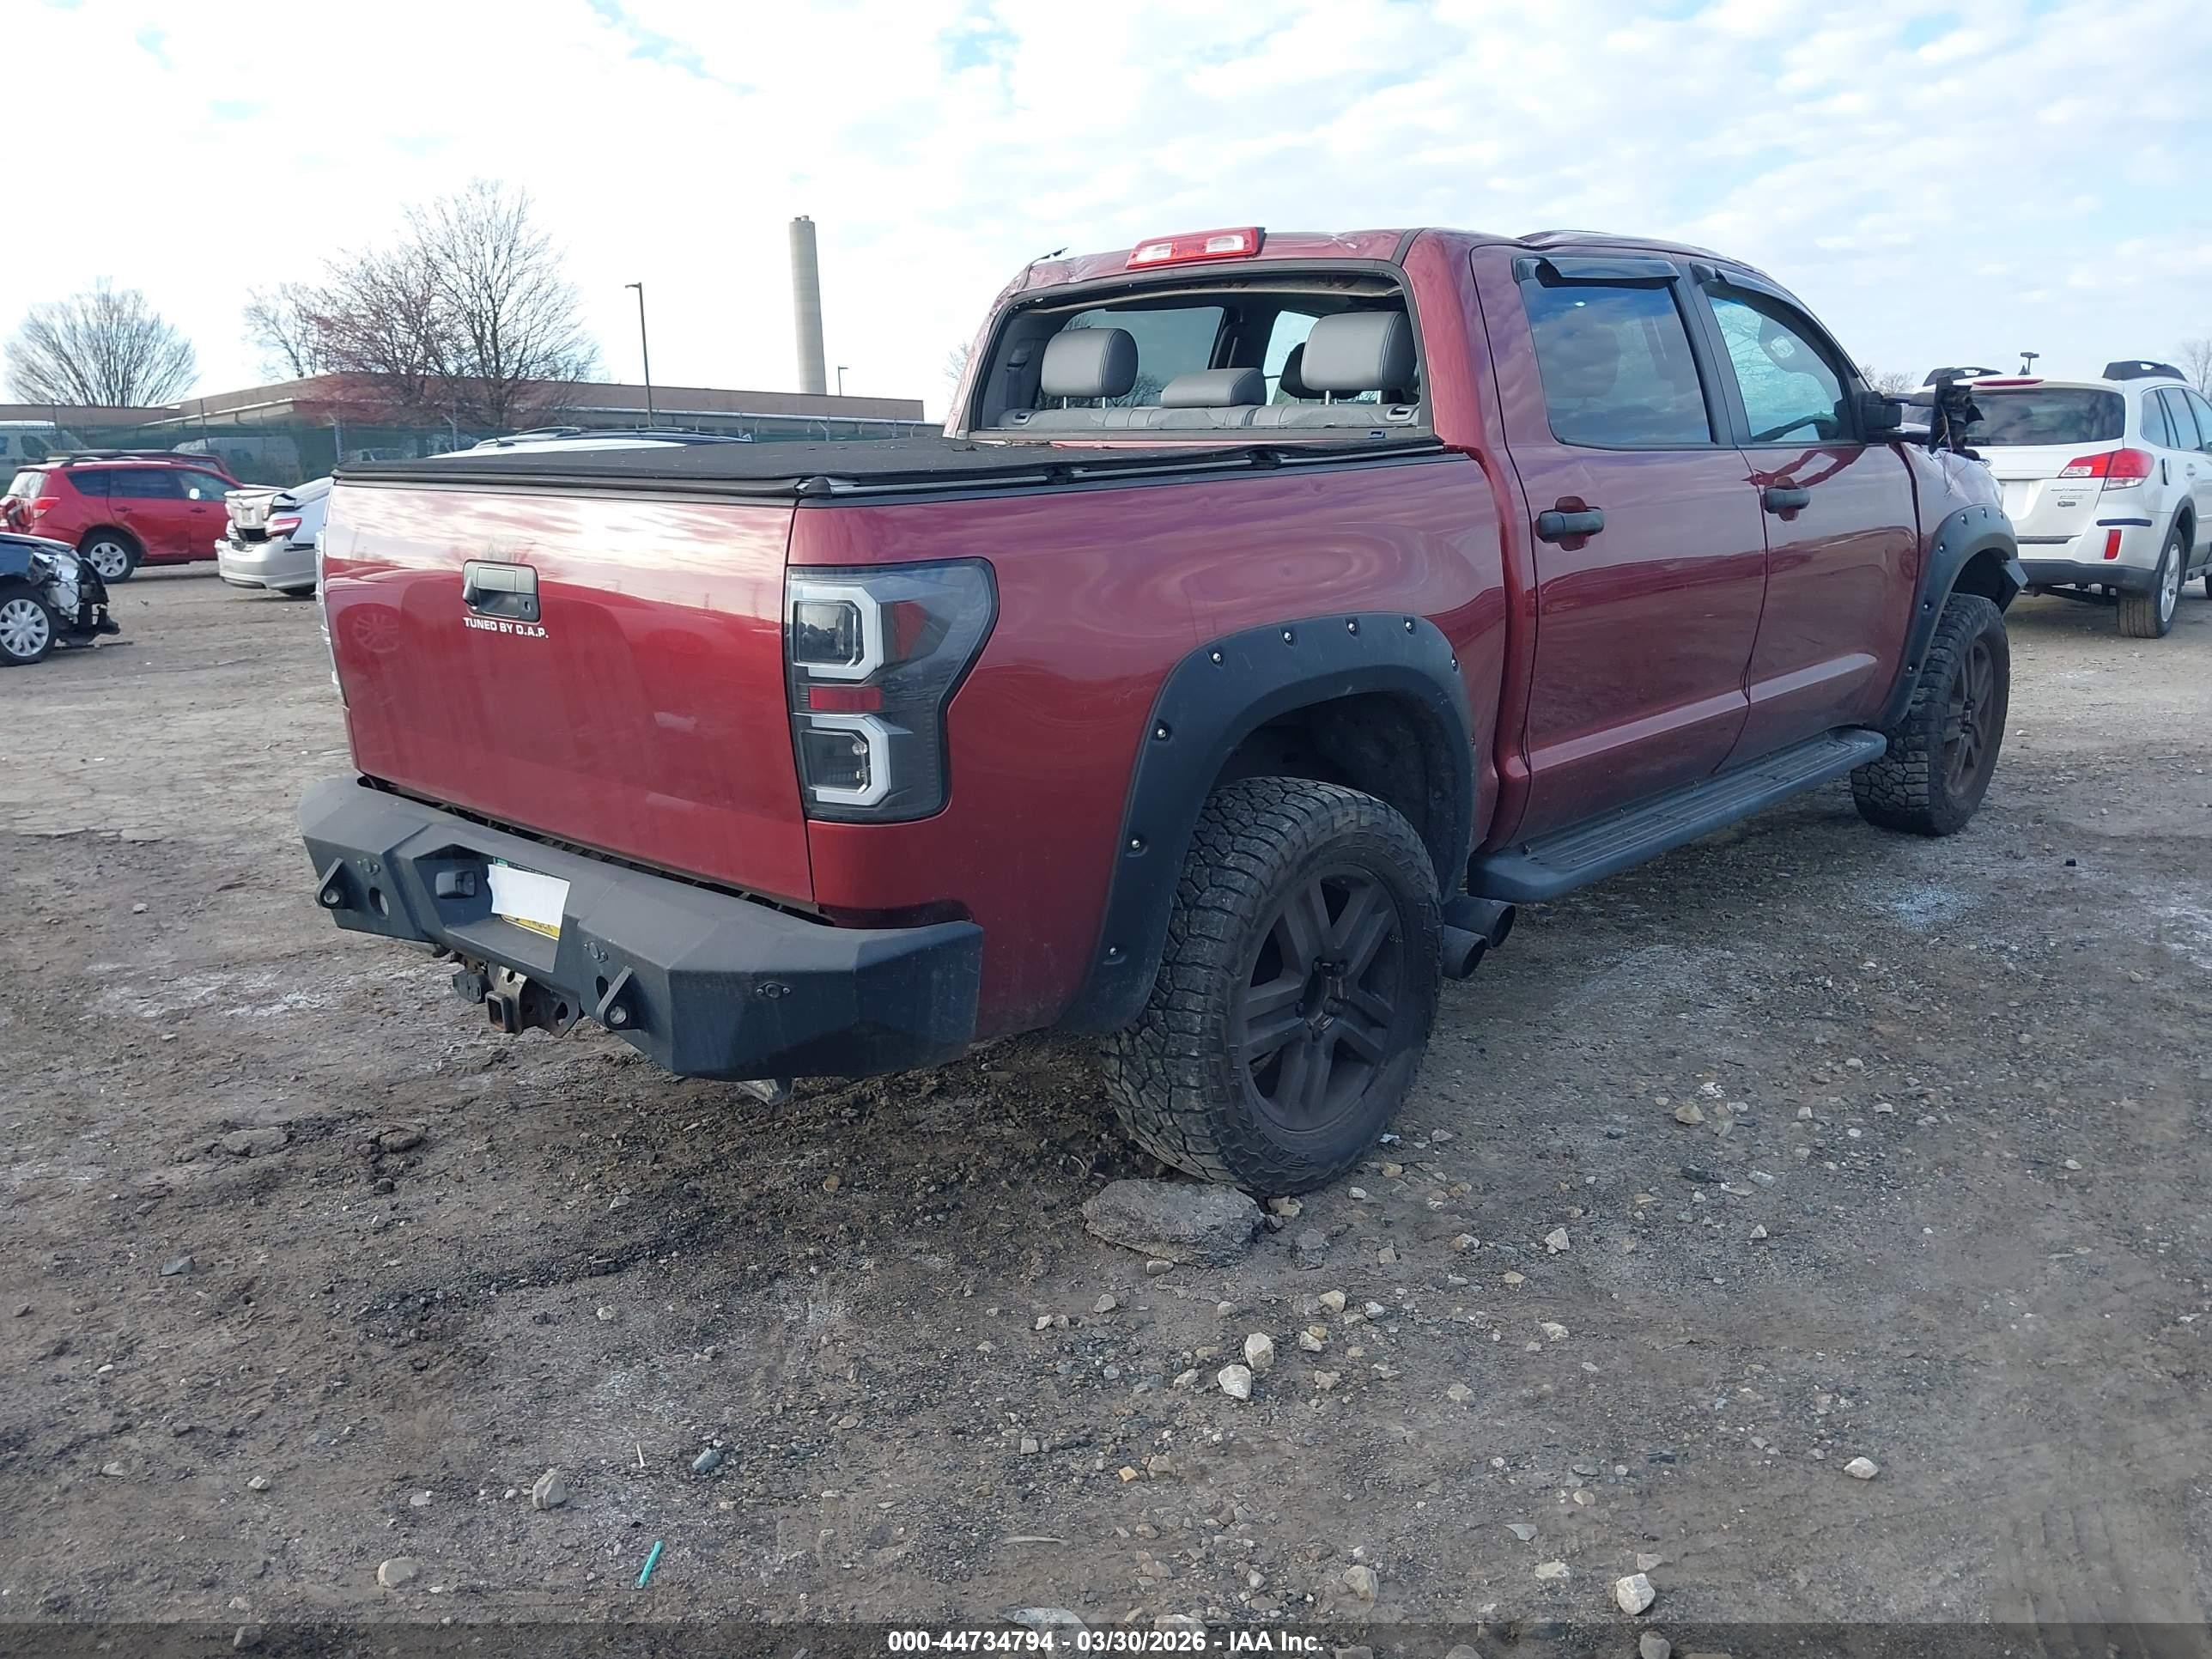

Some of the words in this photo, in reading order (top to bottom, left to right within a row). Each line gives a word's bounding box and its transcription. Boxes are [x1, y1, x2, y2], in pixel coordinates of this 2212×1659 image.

[462, 617, 497, 631] TUNED
[499, 622, 514, 634] BY
[516, 624, 550, 639] D.A.P.
